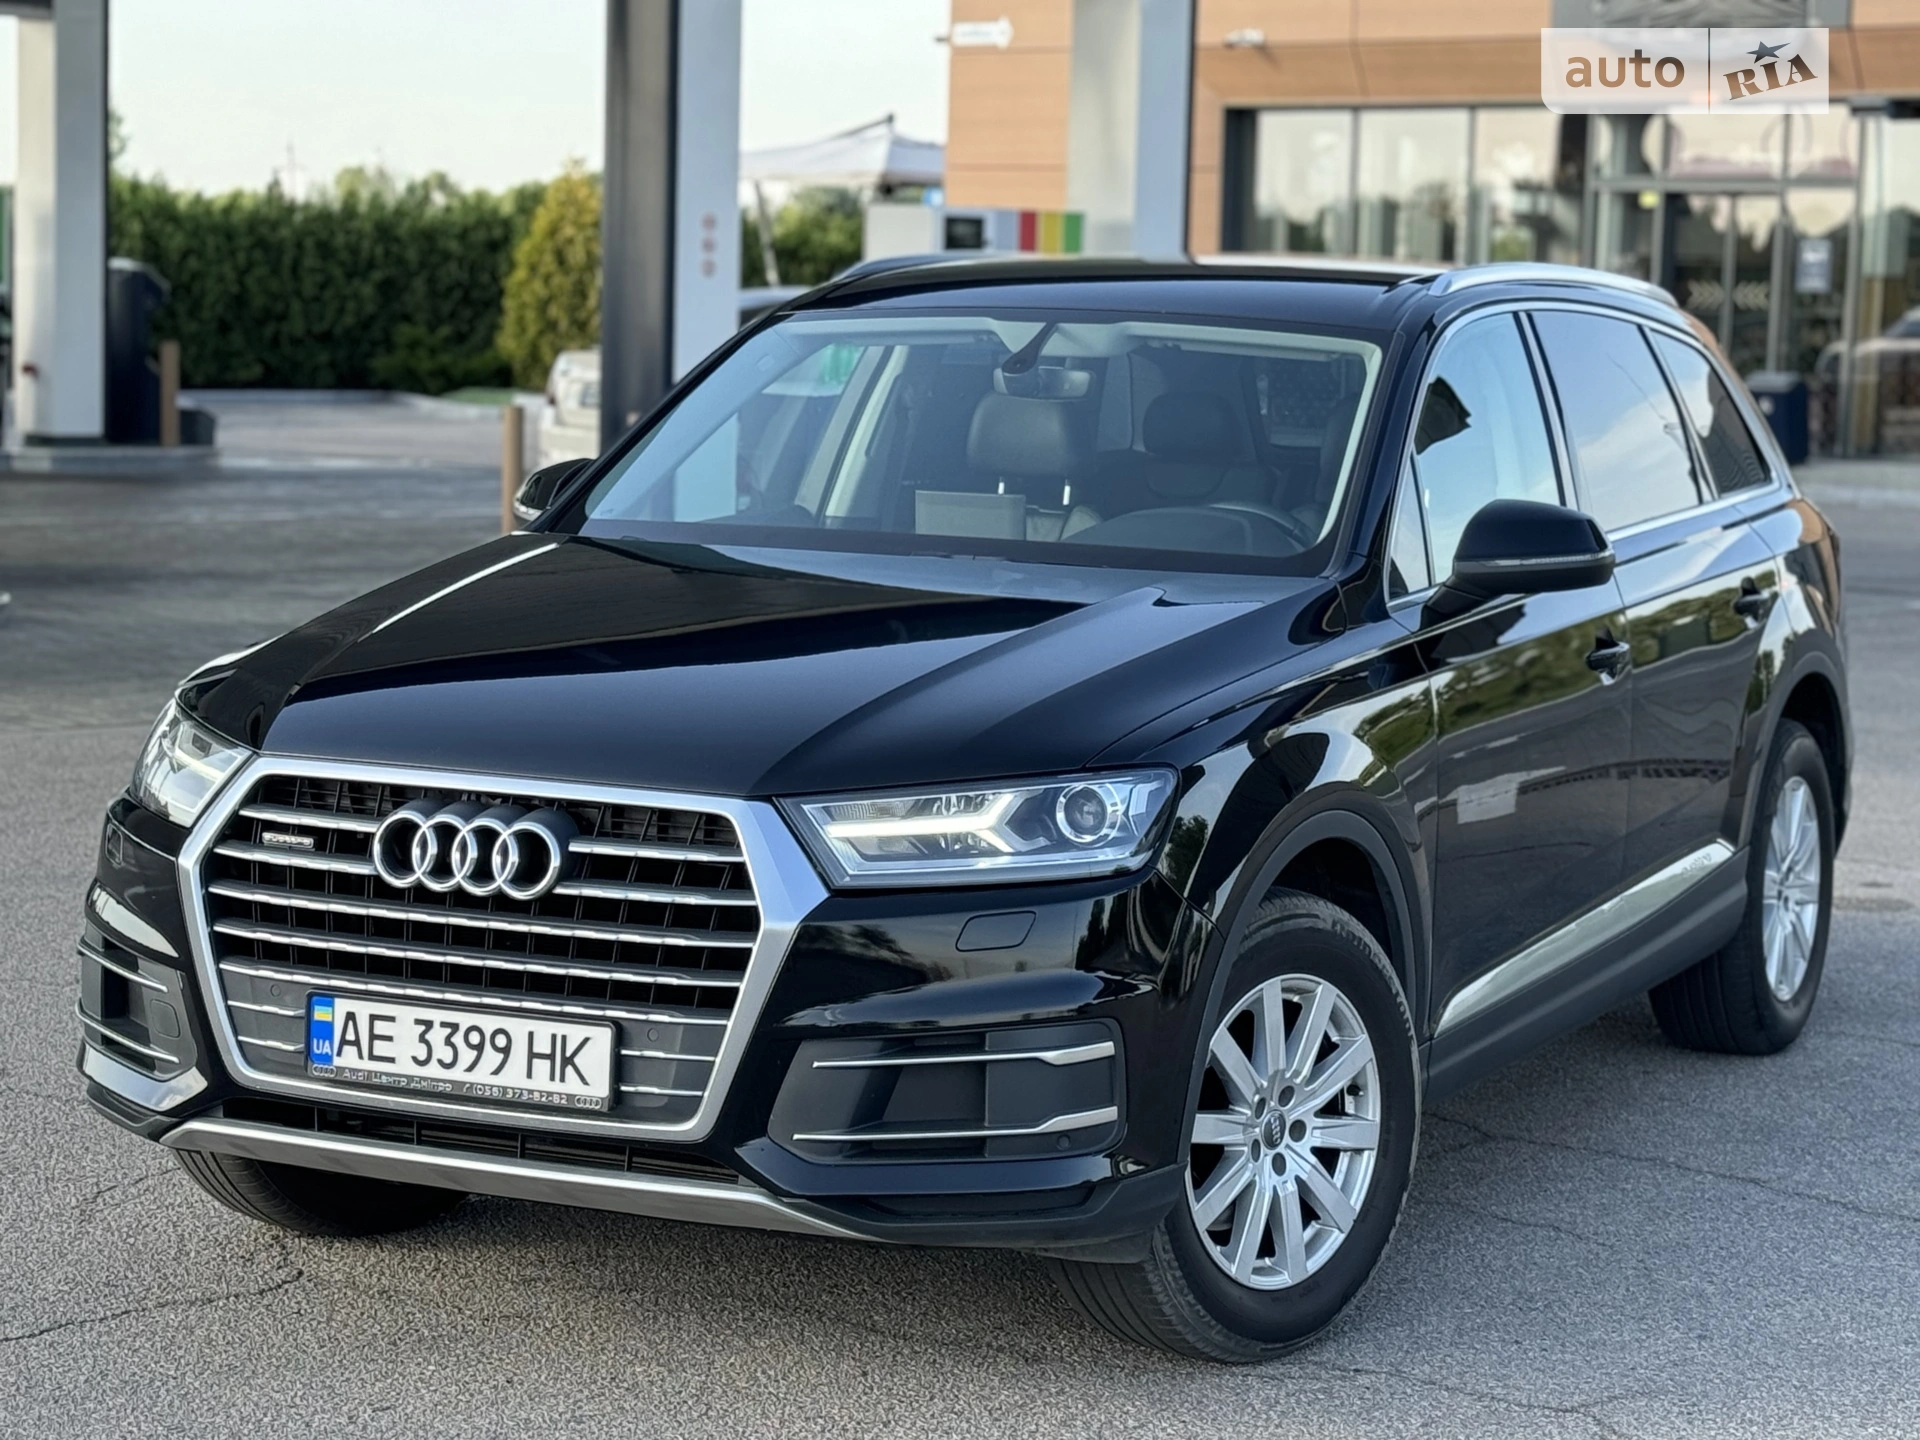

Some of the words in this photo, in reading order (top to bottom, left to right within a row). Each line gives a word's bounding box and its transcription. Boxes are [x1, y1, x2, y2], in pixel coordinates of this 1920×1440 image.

[313, 1038, 332, 1055] UA
[336, 1011, 396, 1064] AE
[411, 1018, 512, 1076] 3399
[526, 1030, 591, 1086] HK
[343, 1068, 368, 1081] Audi
